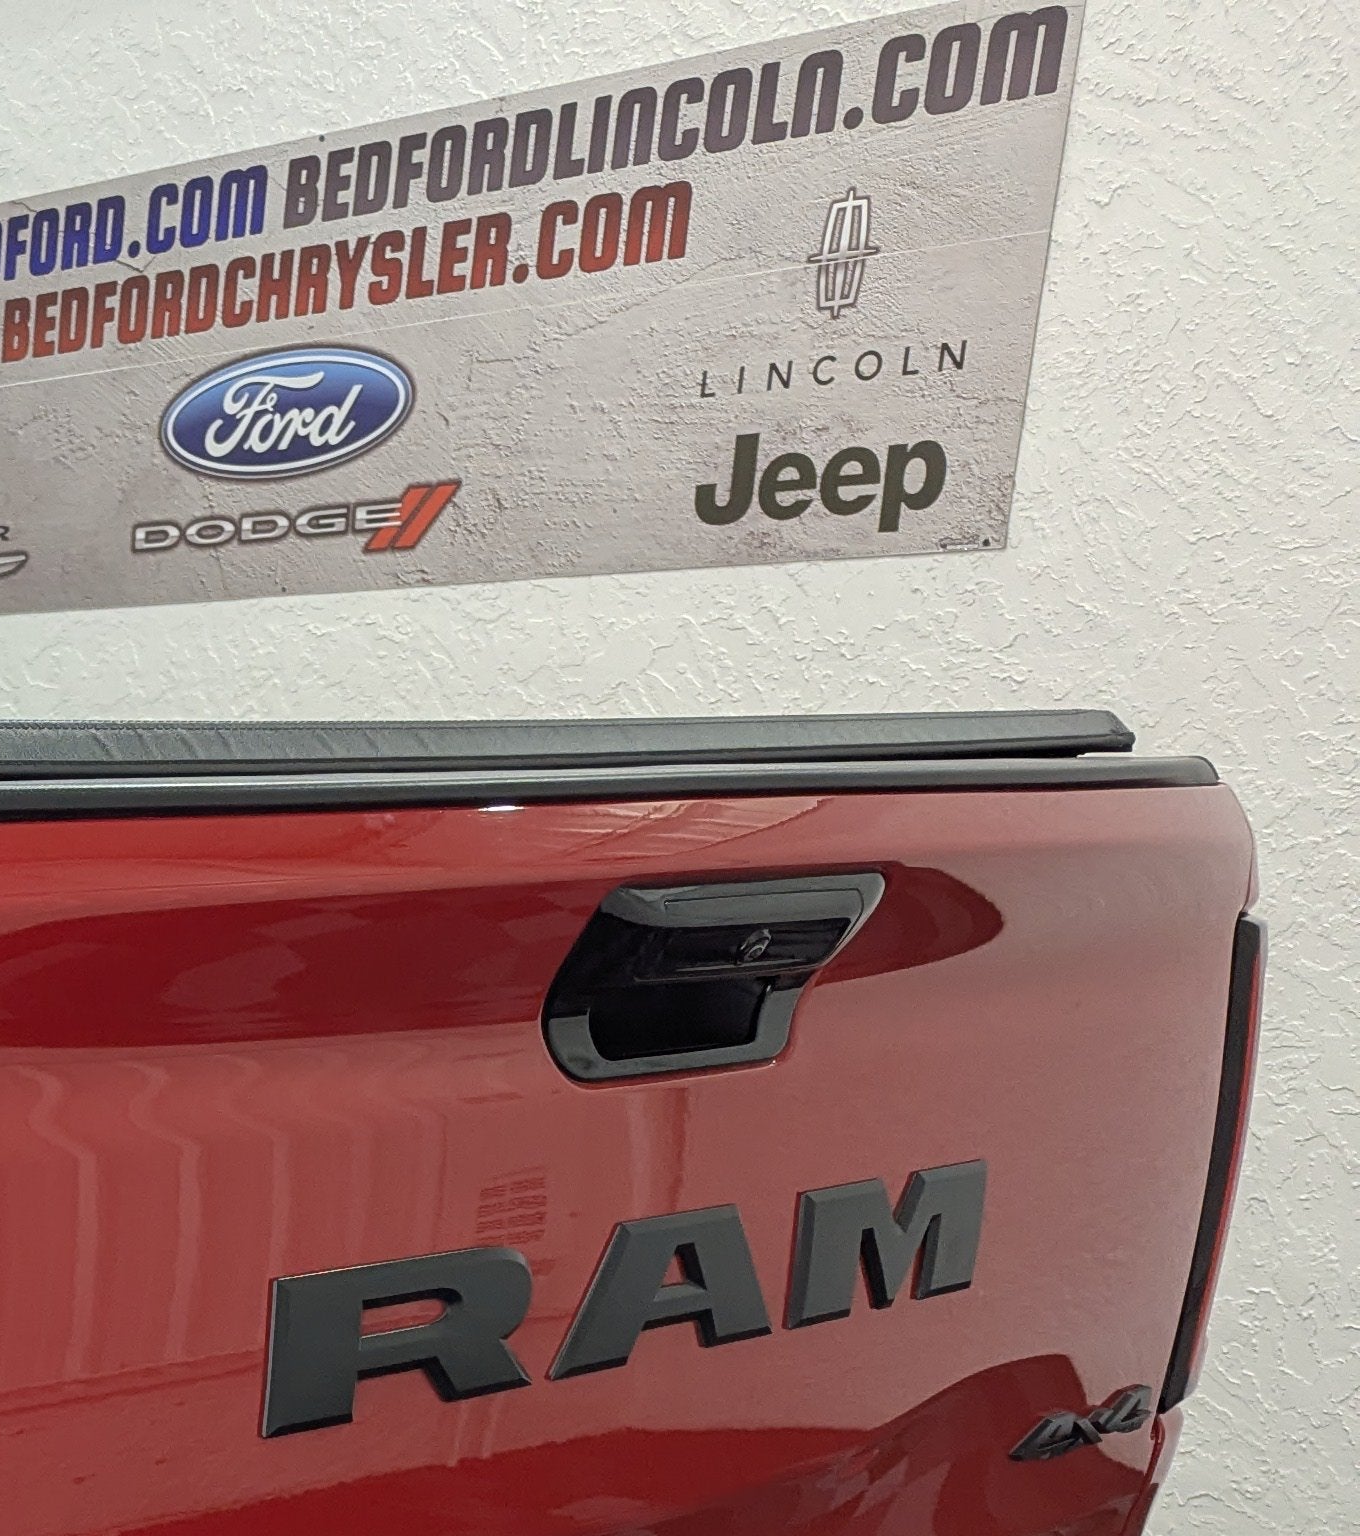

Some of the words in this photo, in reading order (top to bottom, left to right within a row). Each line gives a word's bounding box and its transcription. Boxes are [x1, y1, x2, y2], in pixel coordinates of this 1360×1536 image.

[283, 4, 1069, 230] BEDFORDLINCOLN.COM
[0, 180, 693, 363] BEDFORDCHRYSLER.COM
[203, 370, 364, 458] Ford
[699, 339, 968, 399] LINCOLN
[131, 500, 403, 554] DODGE
[693, 432, 948, 533] Jeep
[259, 1158, 989, 1440] RAM
